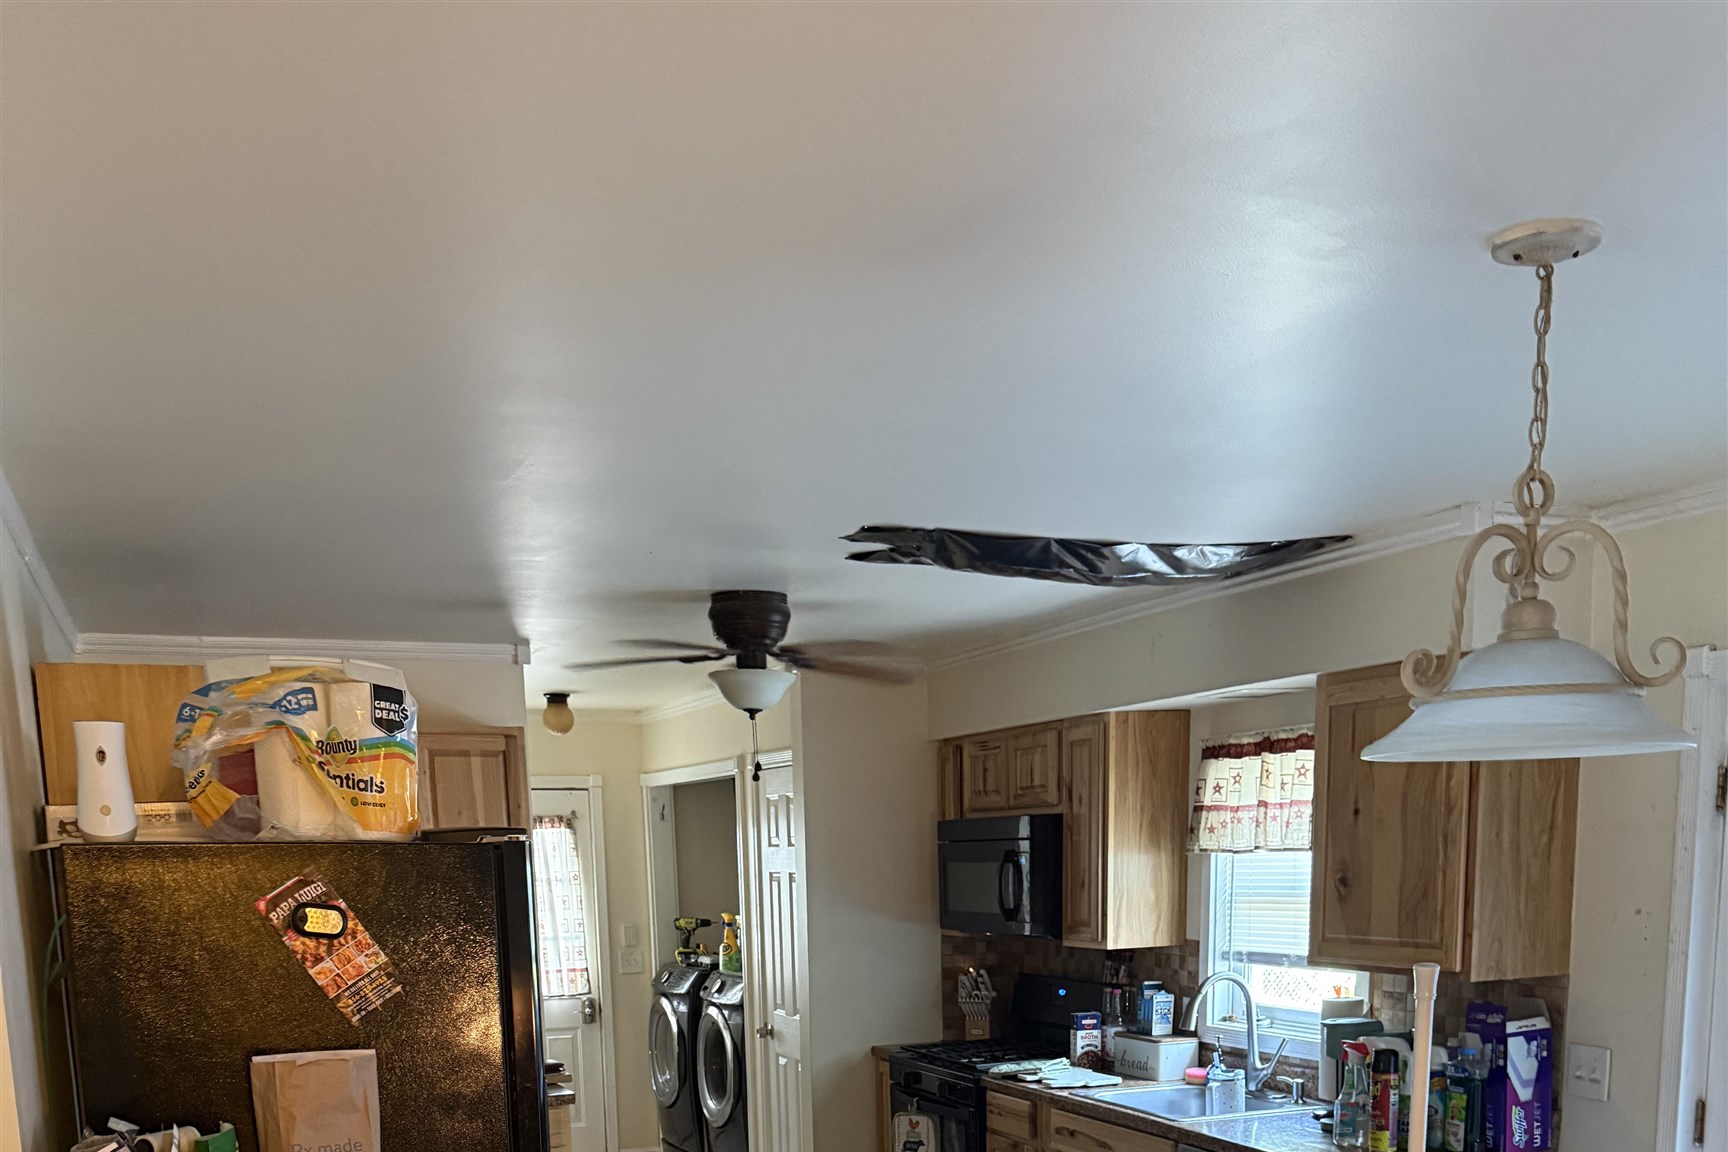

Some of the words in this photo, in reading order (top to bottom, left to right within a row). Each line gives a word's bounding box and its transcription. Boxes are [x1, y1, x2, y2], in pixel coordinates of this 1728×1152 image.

[374, 700, 399, 713] GREAT
[316, 737, 358, 756] Bounty
[268, 897, 298, 923] PAPA
[1117, 1050, 1153, 1073] bread
[1512, 1106, 1525, 1148] Swiffer
